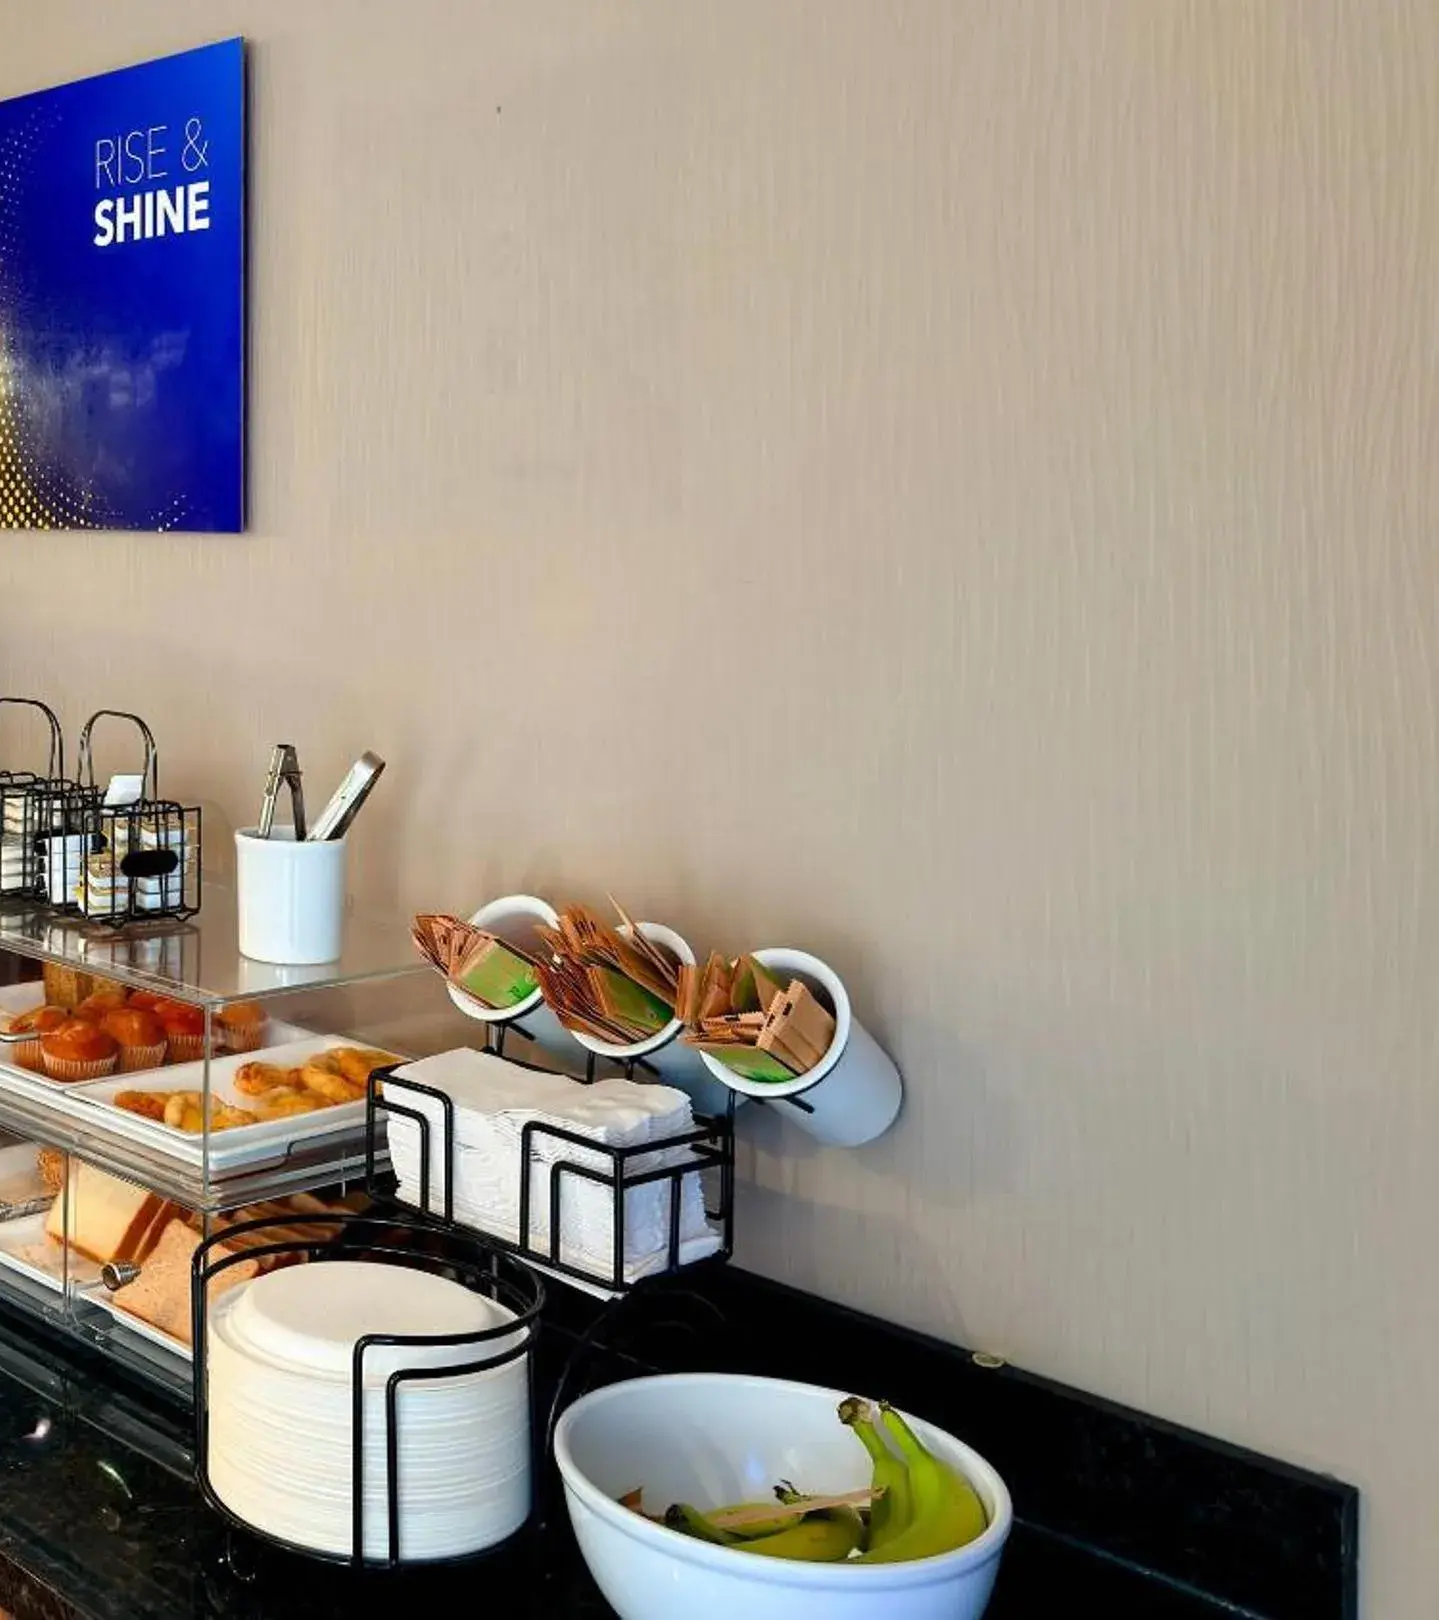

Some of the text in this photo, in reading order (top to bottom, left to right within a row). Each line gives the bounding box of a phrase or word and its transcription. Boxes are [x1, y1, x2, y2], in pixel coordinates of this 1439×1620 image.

[95, 117, 209, 190] RISE &
[93, 181, 210, 247] SHINE
